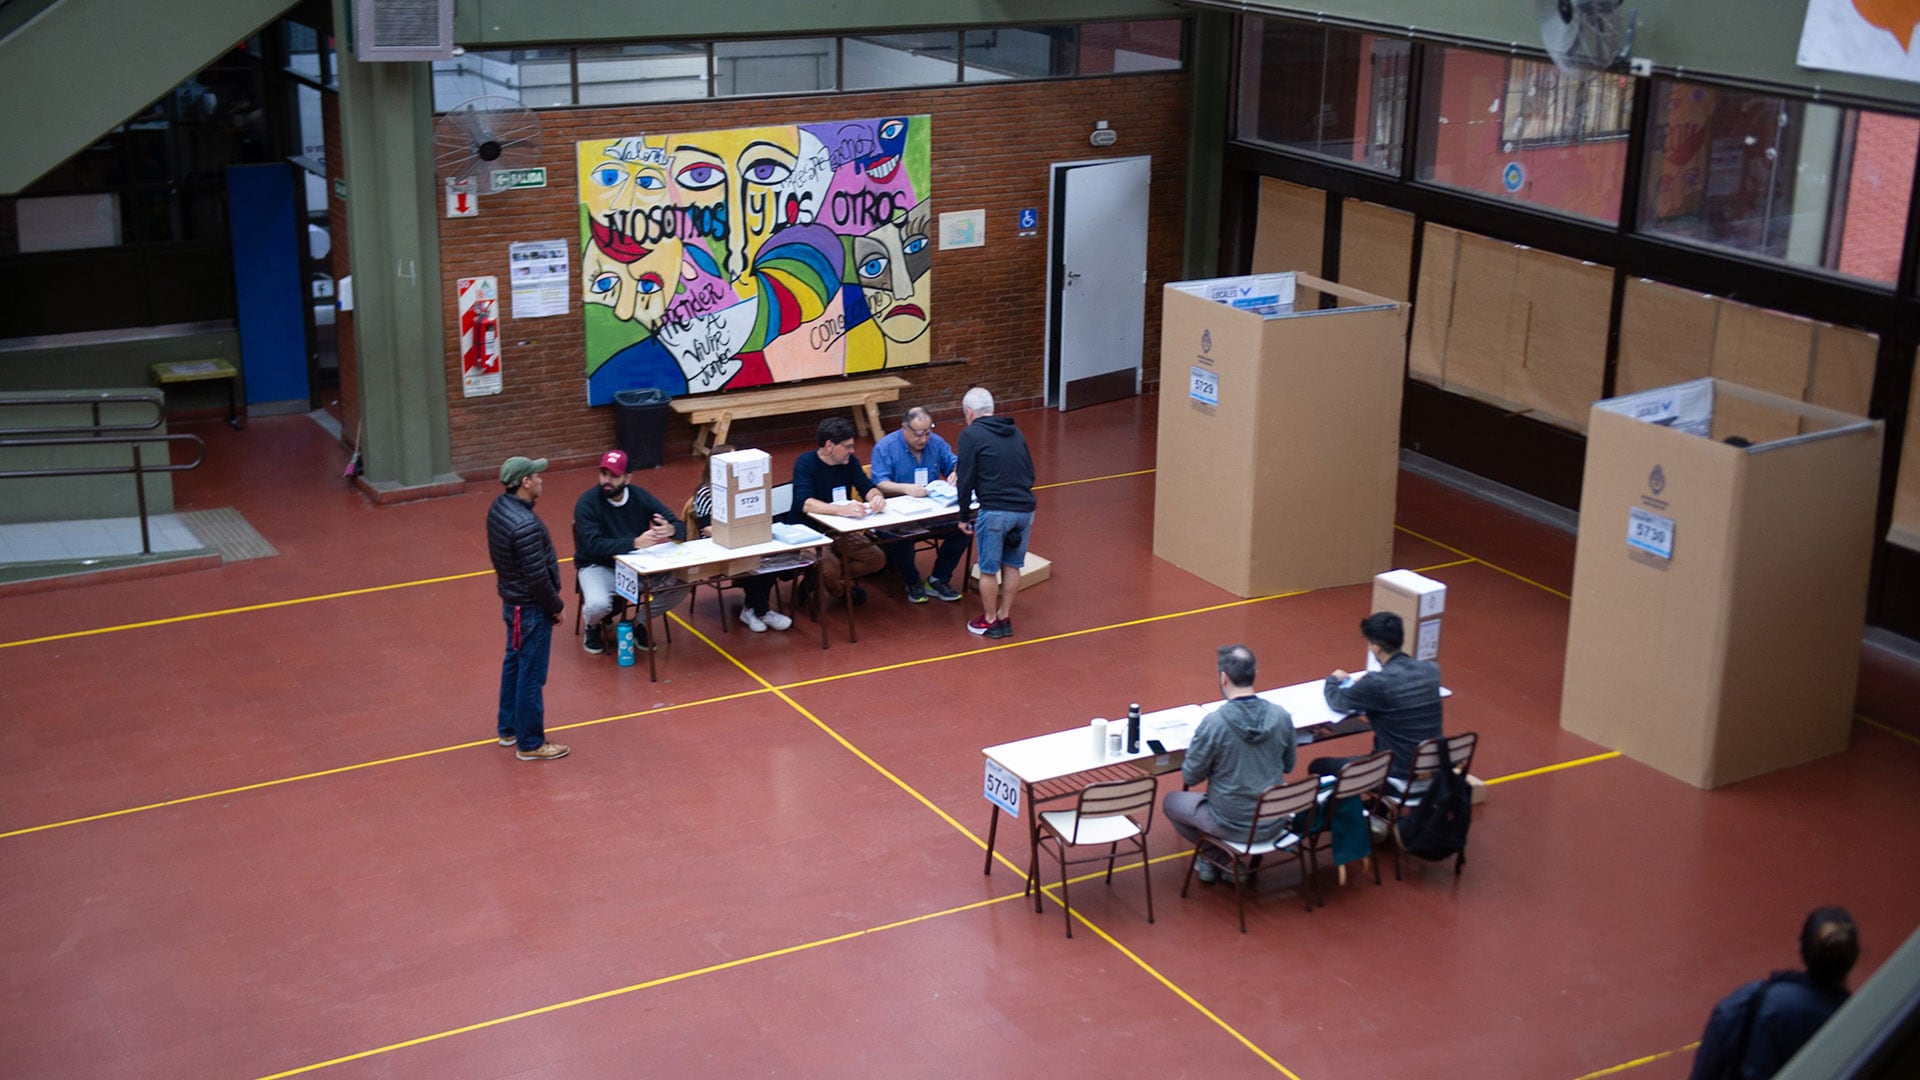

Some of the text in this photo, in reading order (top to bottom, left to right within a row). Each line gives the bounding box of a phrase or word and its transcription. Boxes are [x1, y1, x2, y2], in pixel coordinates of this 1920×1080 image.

[603, 202, 728, 247] NOSOTROS
[771, 190, 814, 234] LOS
[832, 186, 909, 229] OTROS
[1194, 379, 1214, 394] 5729
[741, 495, 759, 505] 5729
[1636, 522, 1666, 544] 5730
[617, 572, 636, 595] 5729
[986, 773, 1017, 806] 5730
